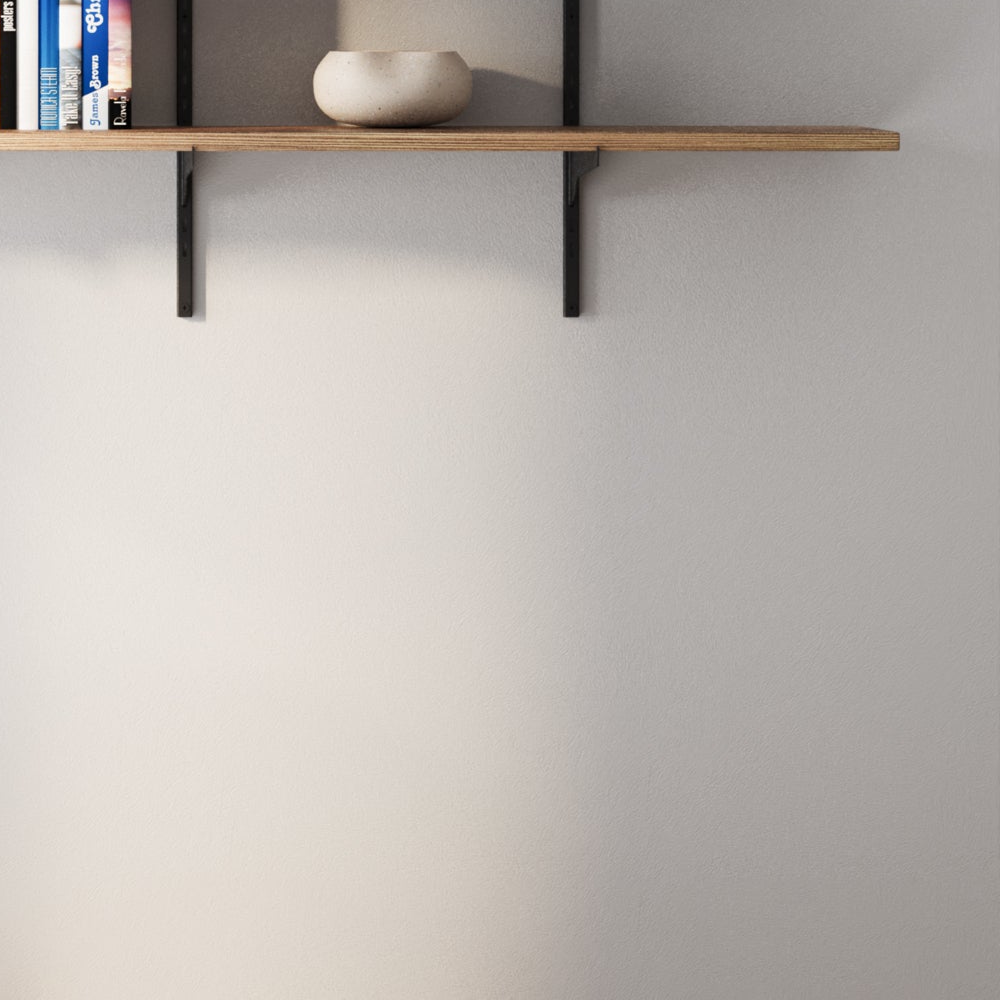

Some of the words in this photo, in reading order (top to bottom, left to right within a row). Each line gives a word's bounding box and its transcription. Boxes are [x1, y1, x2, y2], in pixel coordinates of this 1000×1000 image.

[1, 2, 16, 32] posters
[40, 68, 58, 95] STEAM
[61, 66, 81, 90] Easy!
[89, 55, 100, 90] Brown
[40, 99, 58, 126] MONICA
[61, 101, 78, 125] Take
[89, 92, 100, 126] James
